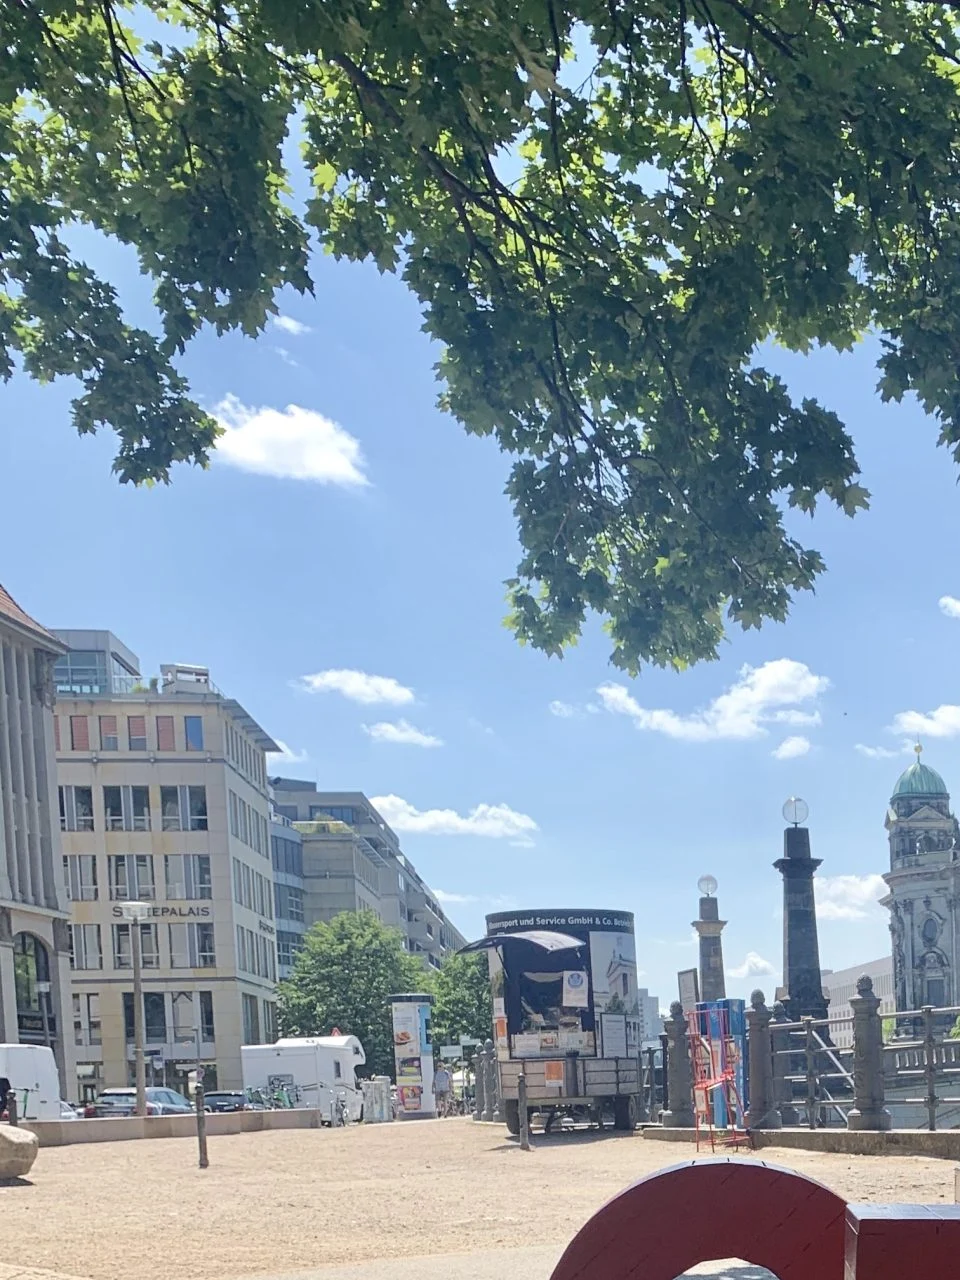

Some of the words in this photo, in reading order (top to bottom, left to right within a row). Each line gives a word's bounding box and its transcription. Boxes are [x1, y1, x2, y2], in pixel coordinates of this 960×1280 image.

[112, 906, 210, 918] SEPALAIS
[519, 917, 534, 926] und
[535, 916, 566, 925] Service
[567, 916, 593, 925] GmbH
[595, 917, 600, 925] &
